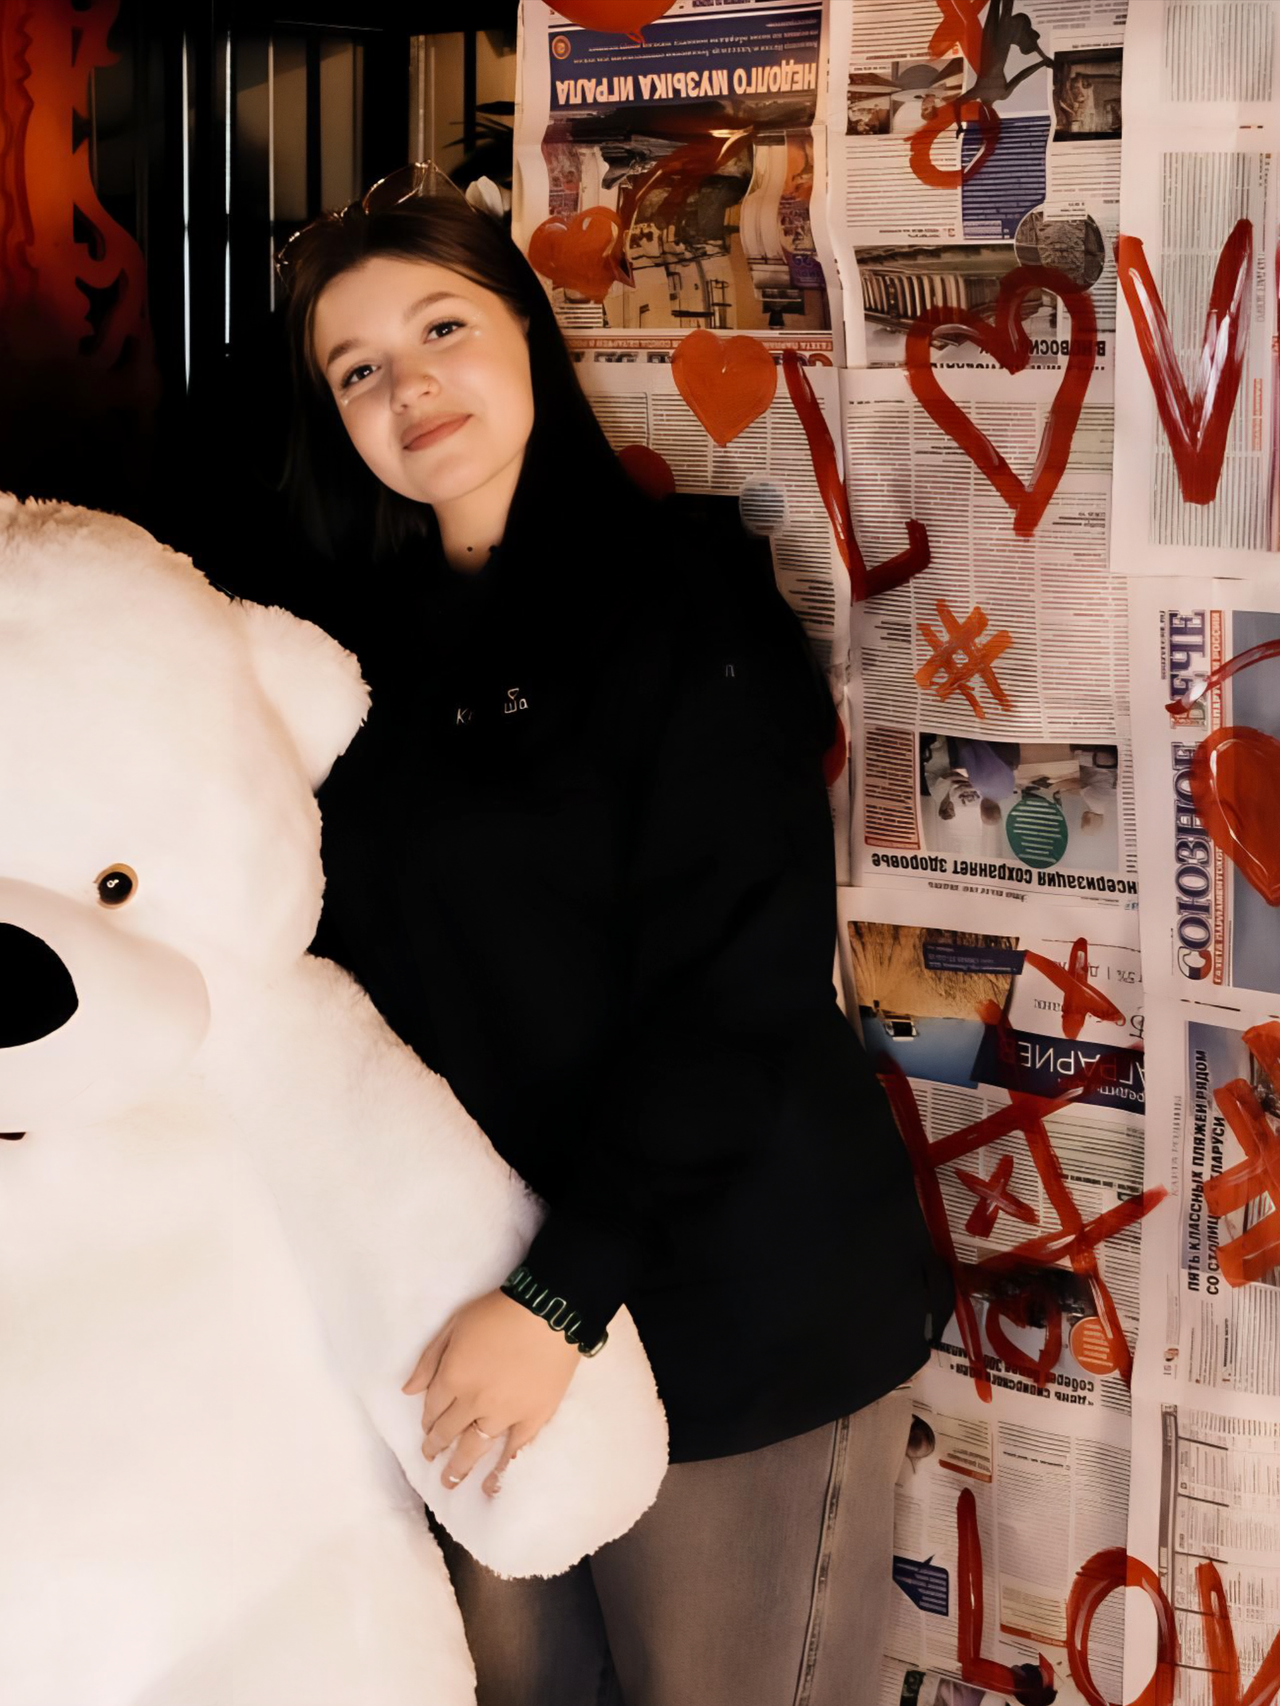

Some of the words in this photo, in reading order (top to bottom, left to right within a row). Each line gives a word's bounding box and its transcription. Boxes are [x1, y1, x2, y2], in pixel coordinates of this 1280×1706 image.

[555, 75, 635, 105] ИГРАЛА
[638, 69, 728, 100] МУЗЫКА
[733, 60, 816, 96] НЕДОЛГО
[870, 853, 947, 874] здоровье
[952, 860, 1032, 886] сохраняет
[1194, 1049, 1210, 1101] РЯДОМ
[1188, 1170, 1205, 1251] КЛАССНЫХ
[1205, 1214, 1222, 1273] СТОЛИЦ
[1187, 1255, 1201, 1292] ПЯТЬ
[1205, 1276, 1220, 1296] СО
